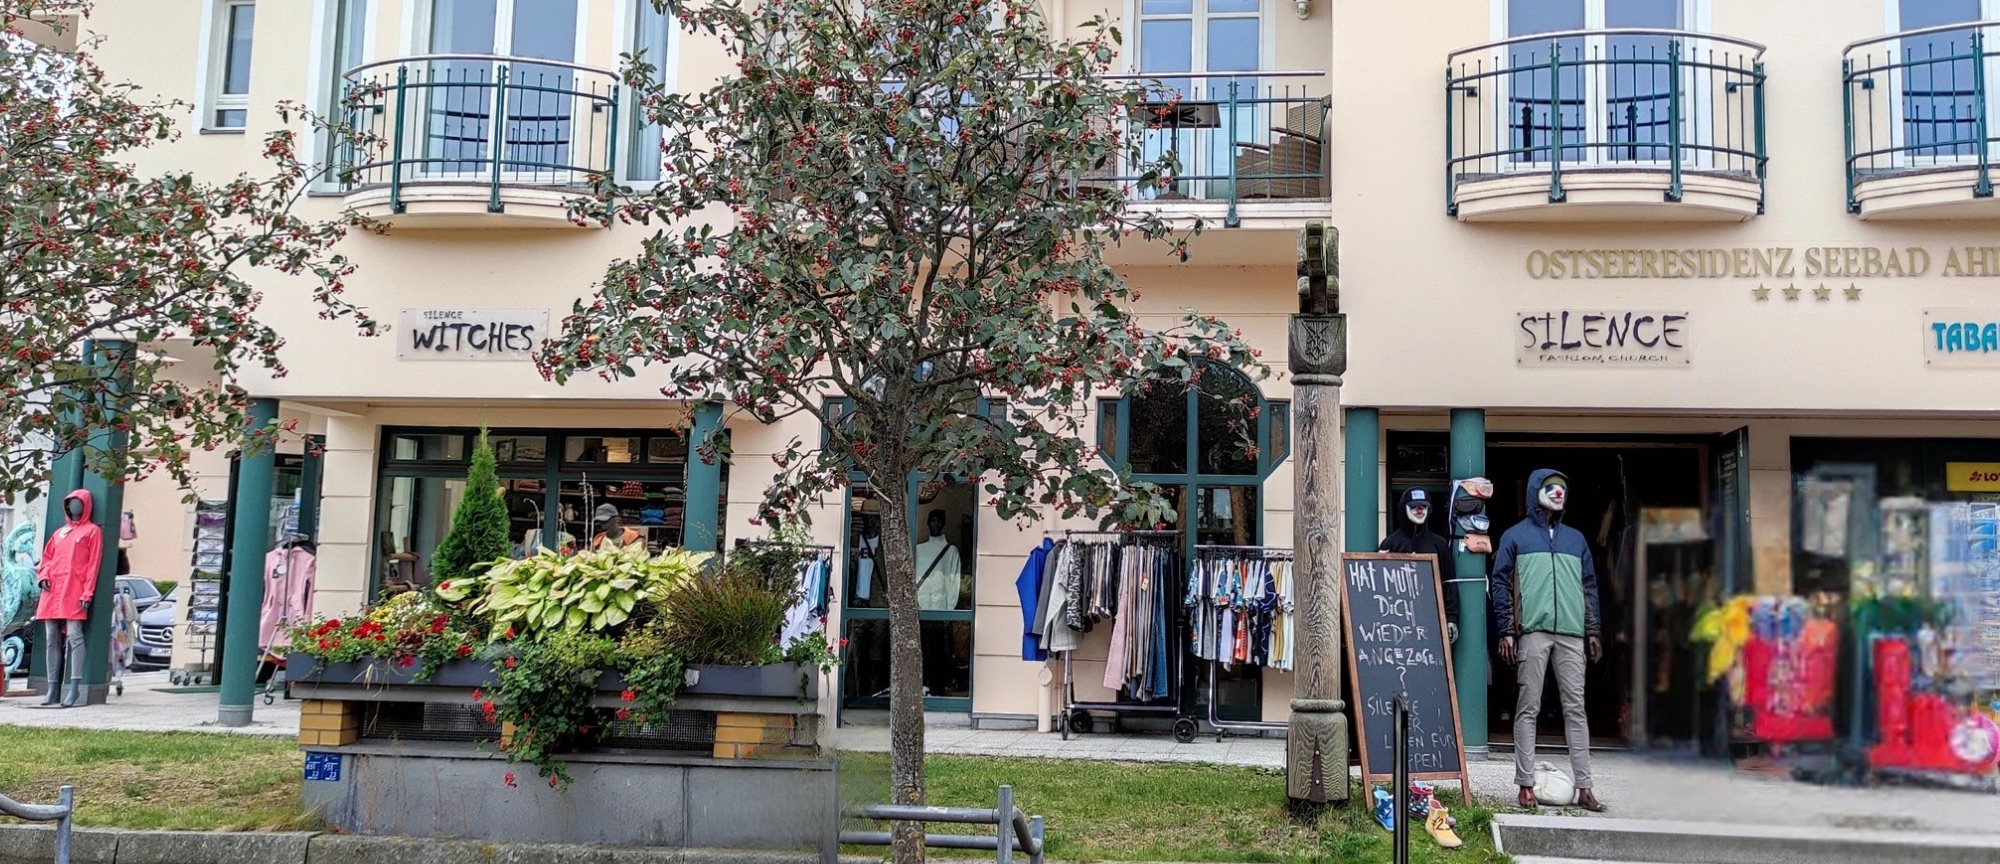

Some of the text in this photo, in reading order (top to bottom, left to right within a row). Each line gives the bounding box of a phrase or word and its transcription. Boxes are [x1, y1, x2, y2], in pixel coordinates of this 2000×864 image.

[1526, 247, 1796, 279] OSTSEERESIDENZ
[1804, 246, 1932, 277] SEEBAD
[423, 310, 463, 319] SILENCE
[1520, 310, 1687, 350] SILENCE
[413, 321, 535, 353] WITCHES
[1931, 322, 2000, 354] TABA
[1608, 354, 1668, 362] CHURCH
